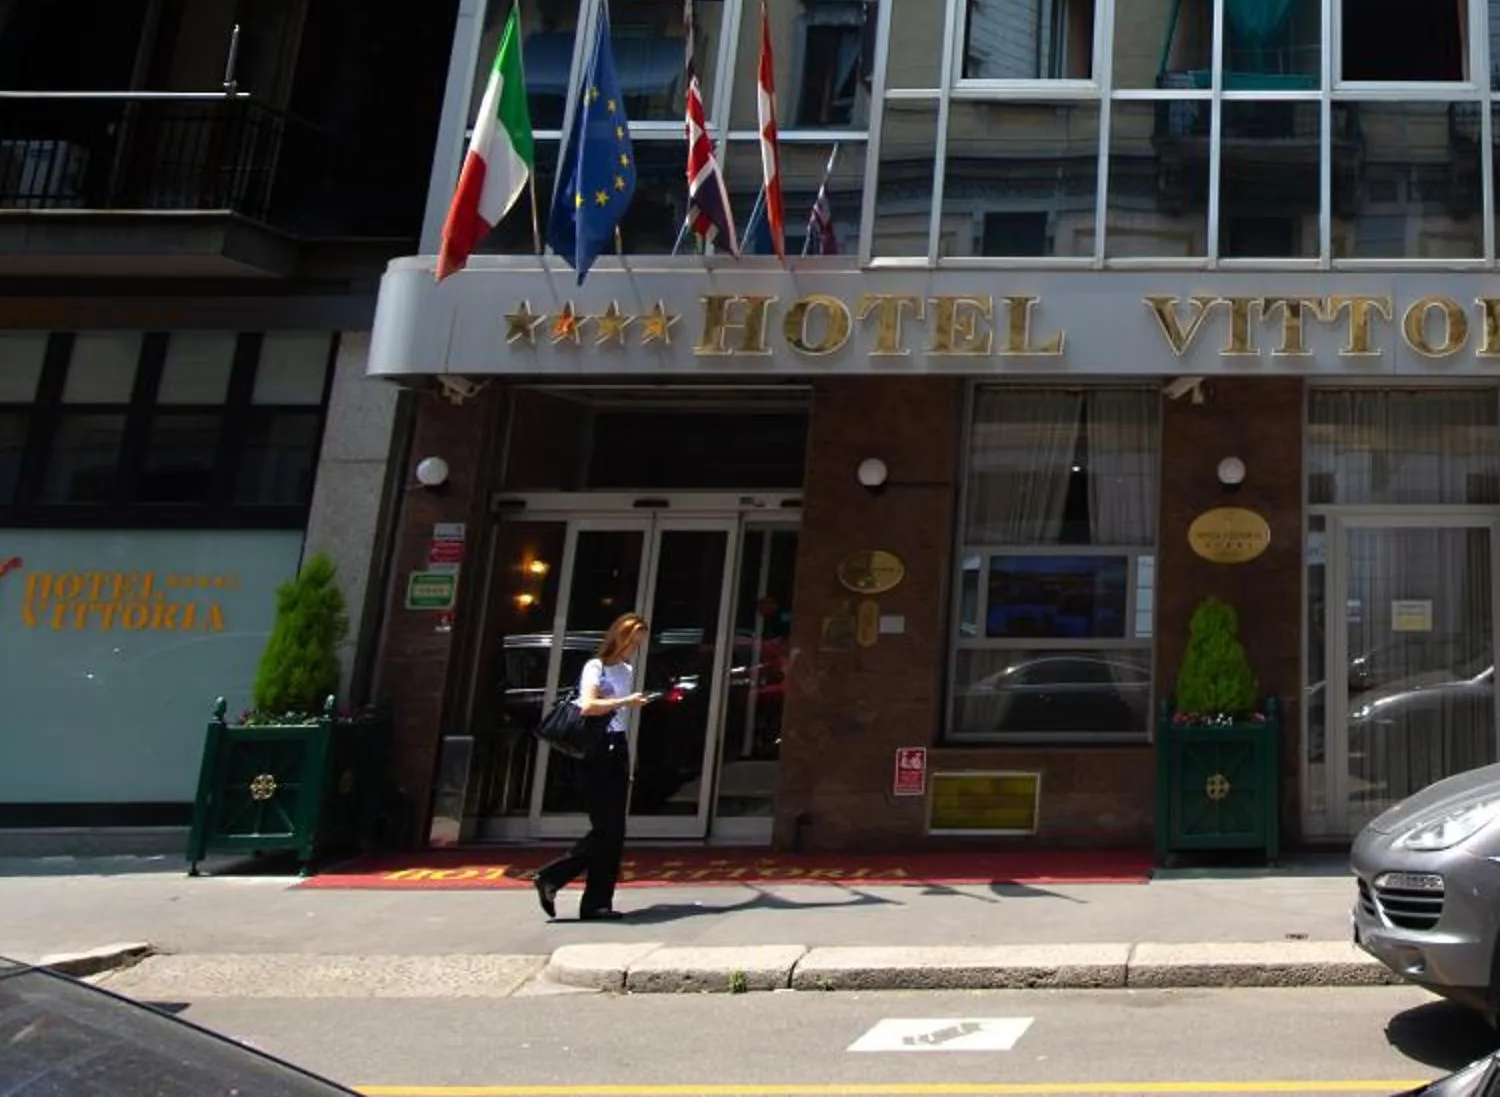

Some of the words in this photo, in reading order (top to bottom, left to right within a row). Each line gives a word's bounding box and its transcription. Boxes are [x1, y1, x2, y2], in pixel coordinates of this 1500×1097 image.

[694, 294, 1066, 357] HOTEL
[25, 571, 166, 605] HOTEL
[22, 598, 225, 631] VITTORIA
